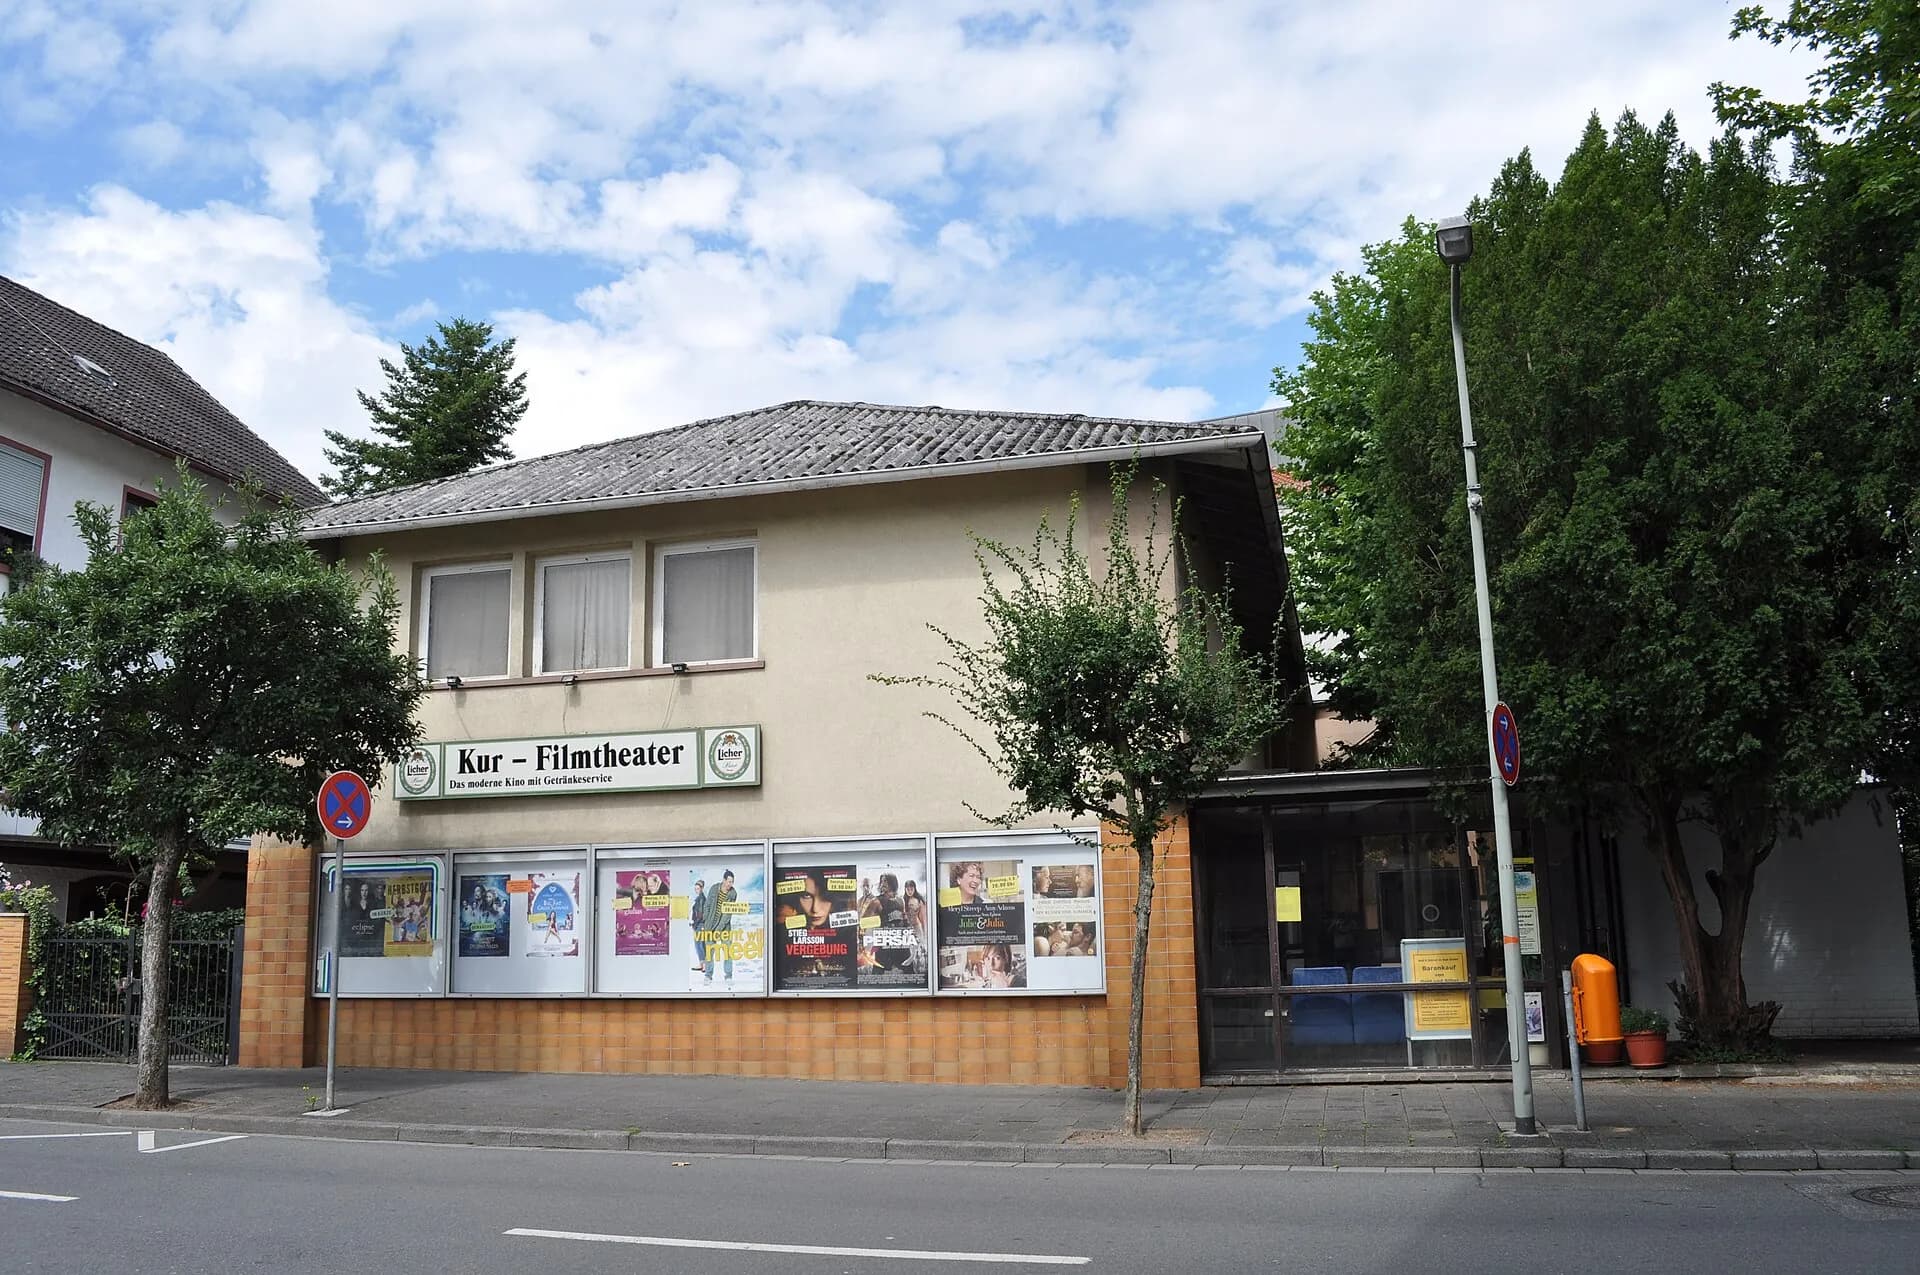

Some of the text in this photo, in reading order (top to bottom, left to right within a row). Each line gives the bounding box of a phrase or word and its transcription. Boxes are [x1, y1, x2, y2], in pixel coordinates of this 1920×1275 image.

[458, 748, 504, 774] Kur
[536, 741, 685, 771] Filmtheater
[717, 748, 744, 761] Licher
[407, 764, 429, 776] Licher
[450, 773, 613, 789] Das moderne Kino mit Getränkeservice
[694, 928, 744, 942] vincent
[788, 928, 808, 937] STIEG
[902, 928, 914, 936] OF
[793, 936, 825, 945] LARSSON
[863, 935, 918, 947] PERSIA
[785, 944, 848, 955] VERGEBUNG
